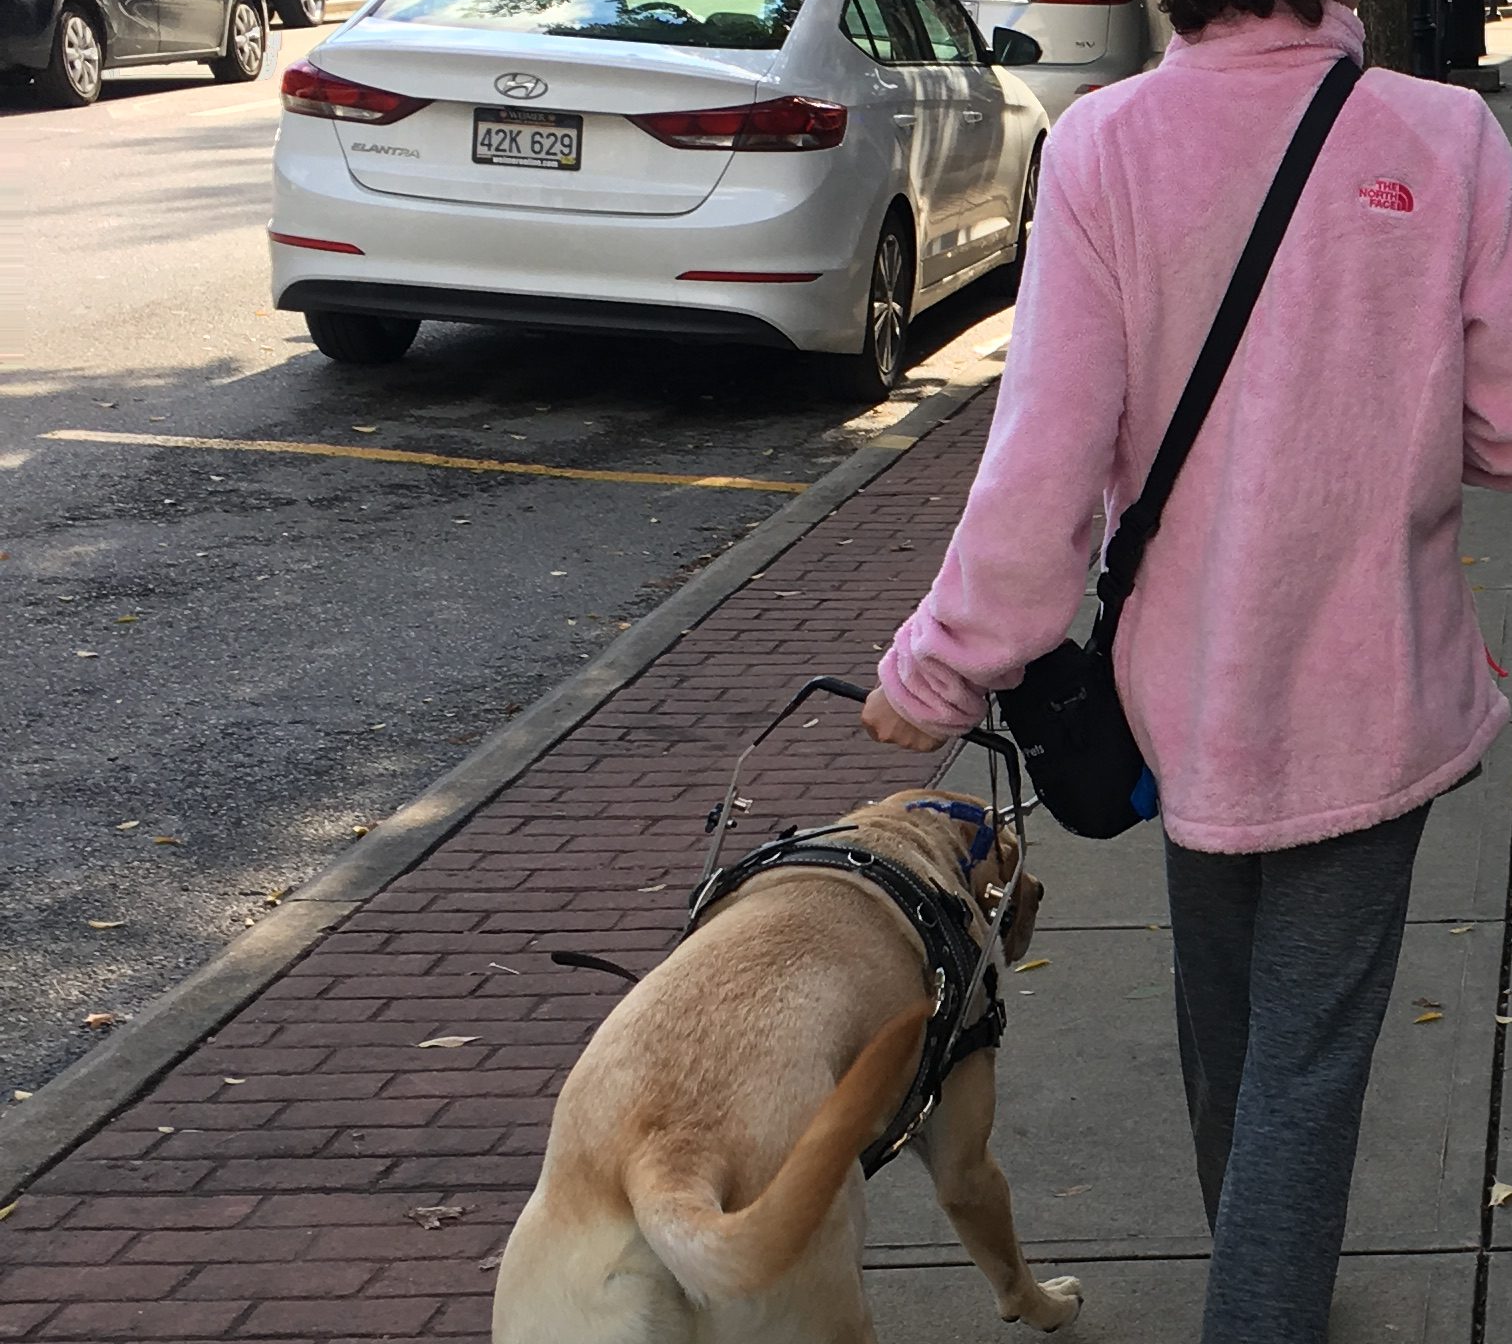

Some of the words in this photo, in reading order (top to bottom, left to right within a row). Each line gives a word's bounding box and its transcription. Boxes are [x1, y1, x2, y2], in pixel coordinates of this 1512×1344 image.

[480, 127, 522, 154] 42K
[531, 131, 573, 157] 629
[351, 142, 420, 159] ELANTRA
[1375, 180, 1399, 192] THE
[1359, 188, 1399, 201] NORTH
[1369, 198, 1397, 210] FACE
